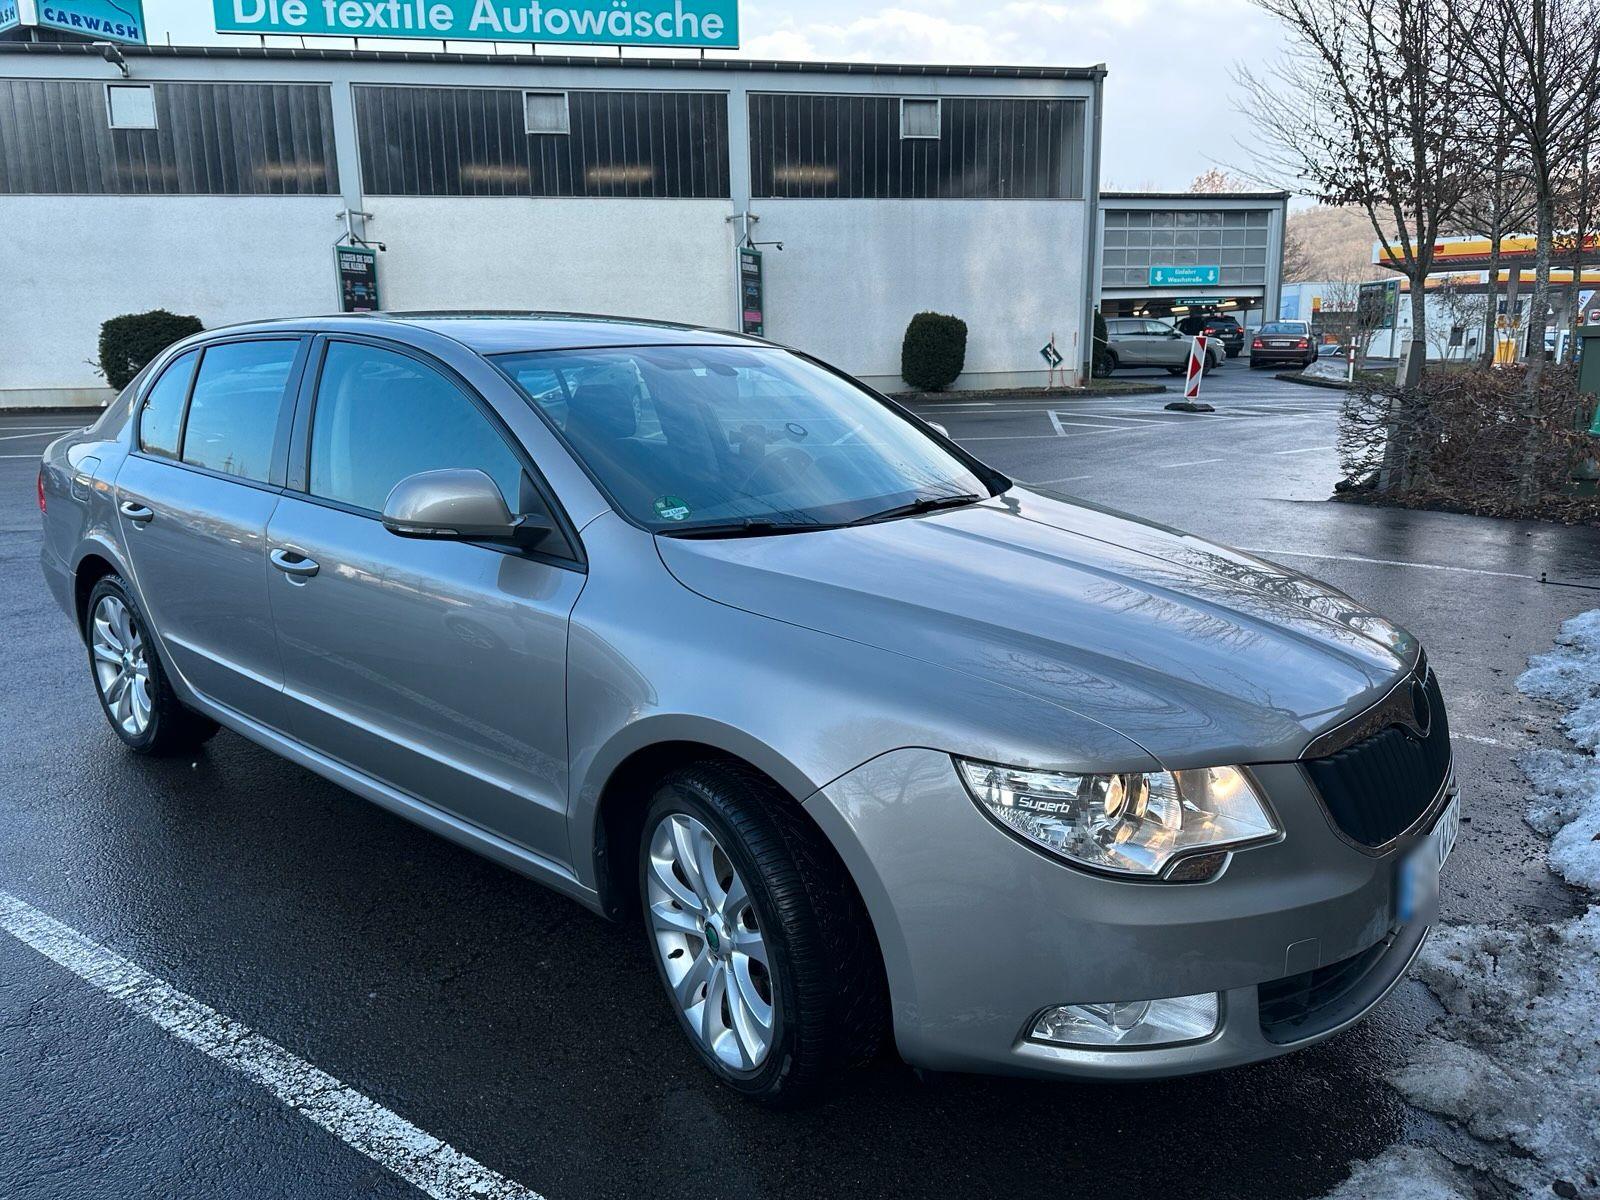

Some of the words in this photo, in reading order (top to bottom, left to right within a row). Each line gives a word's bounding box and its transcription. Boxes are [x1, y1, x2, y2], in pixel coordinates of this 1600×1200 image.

[44, 7, 139, 39] CARWASH
[234, 0, 308, 26] Die
[322, 0, 454, 31] textile
[468, 0, 725, 38] Autowäsche
[1018, 796, 1070, 813] Superb
